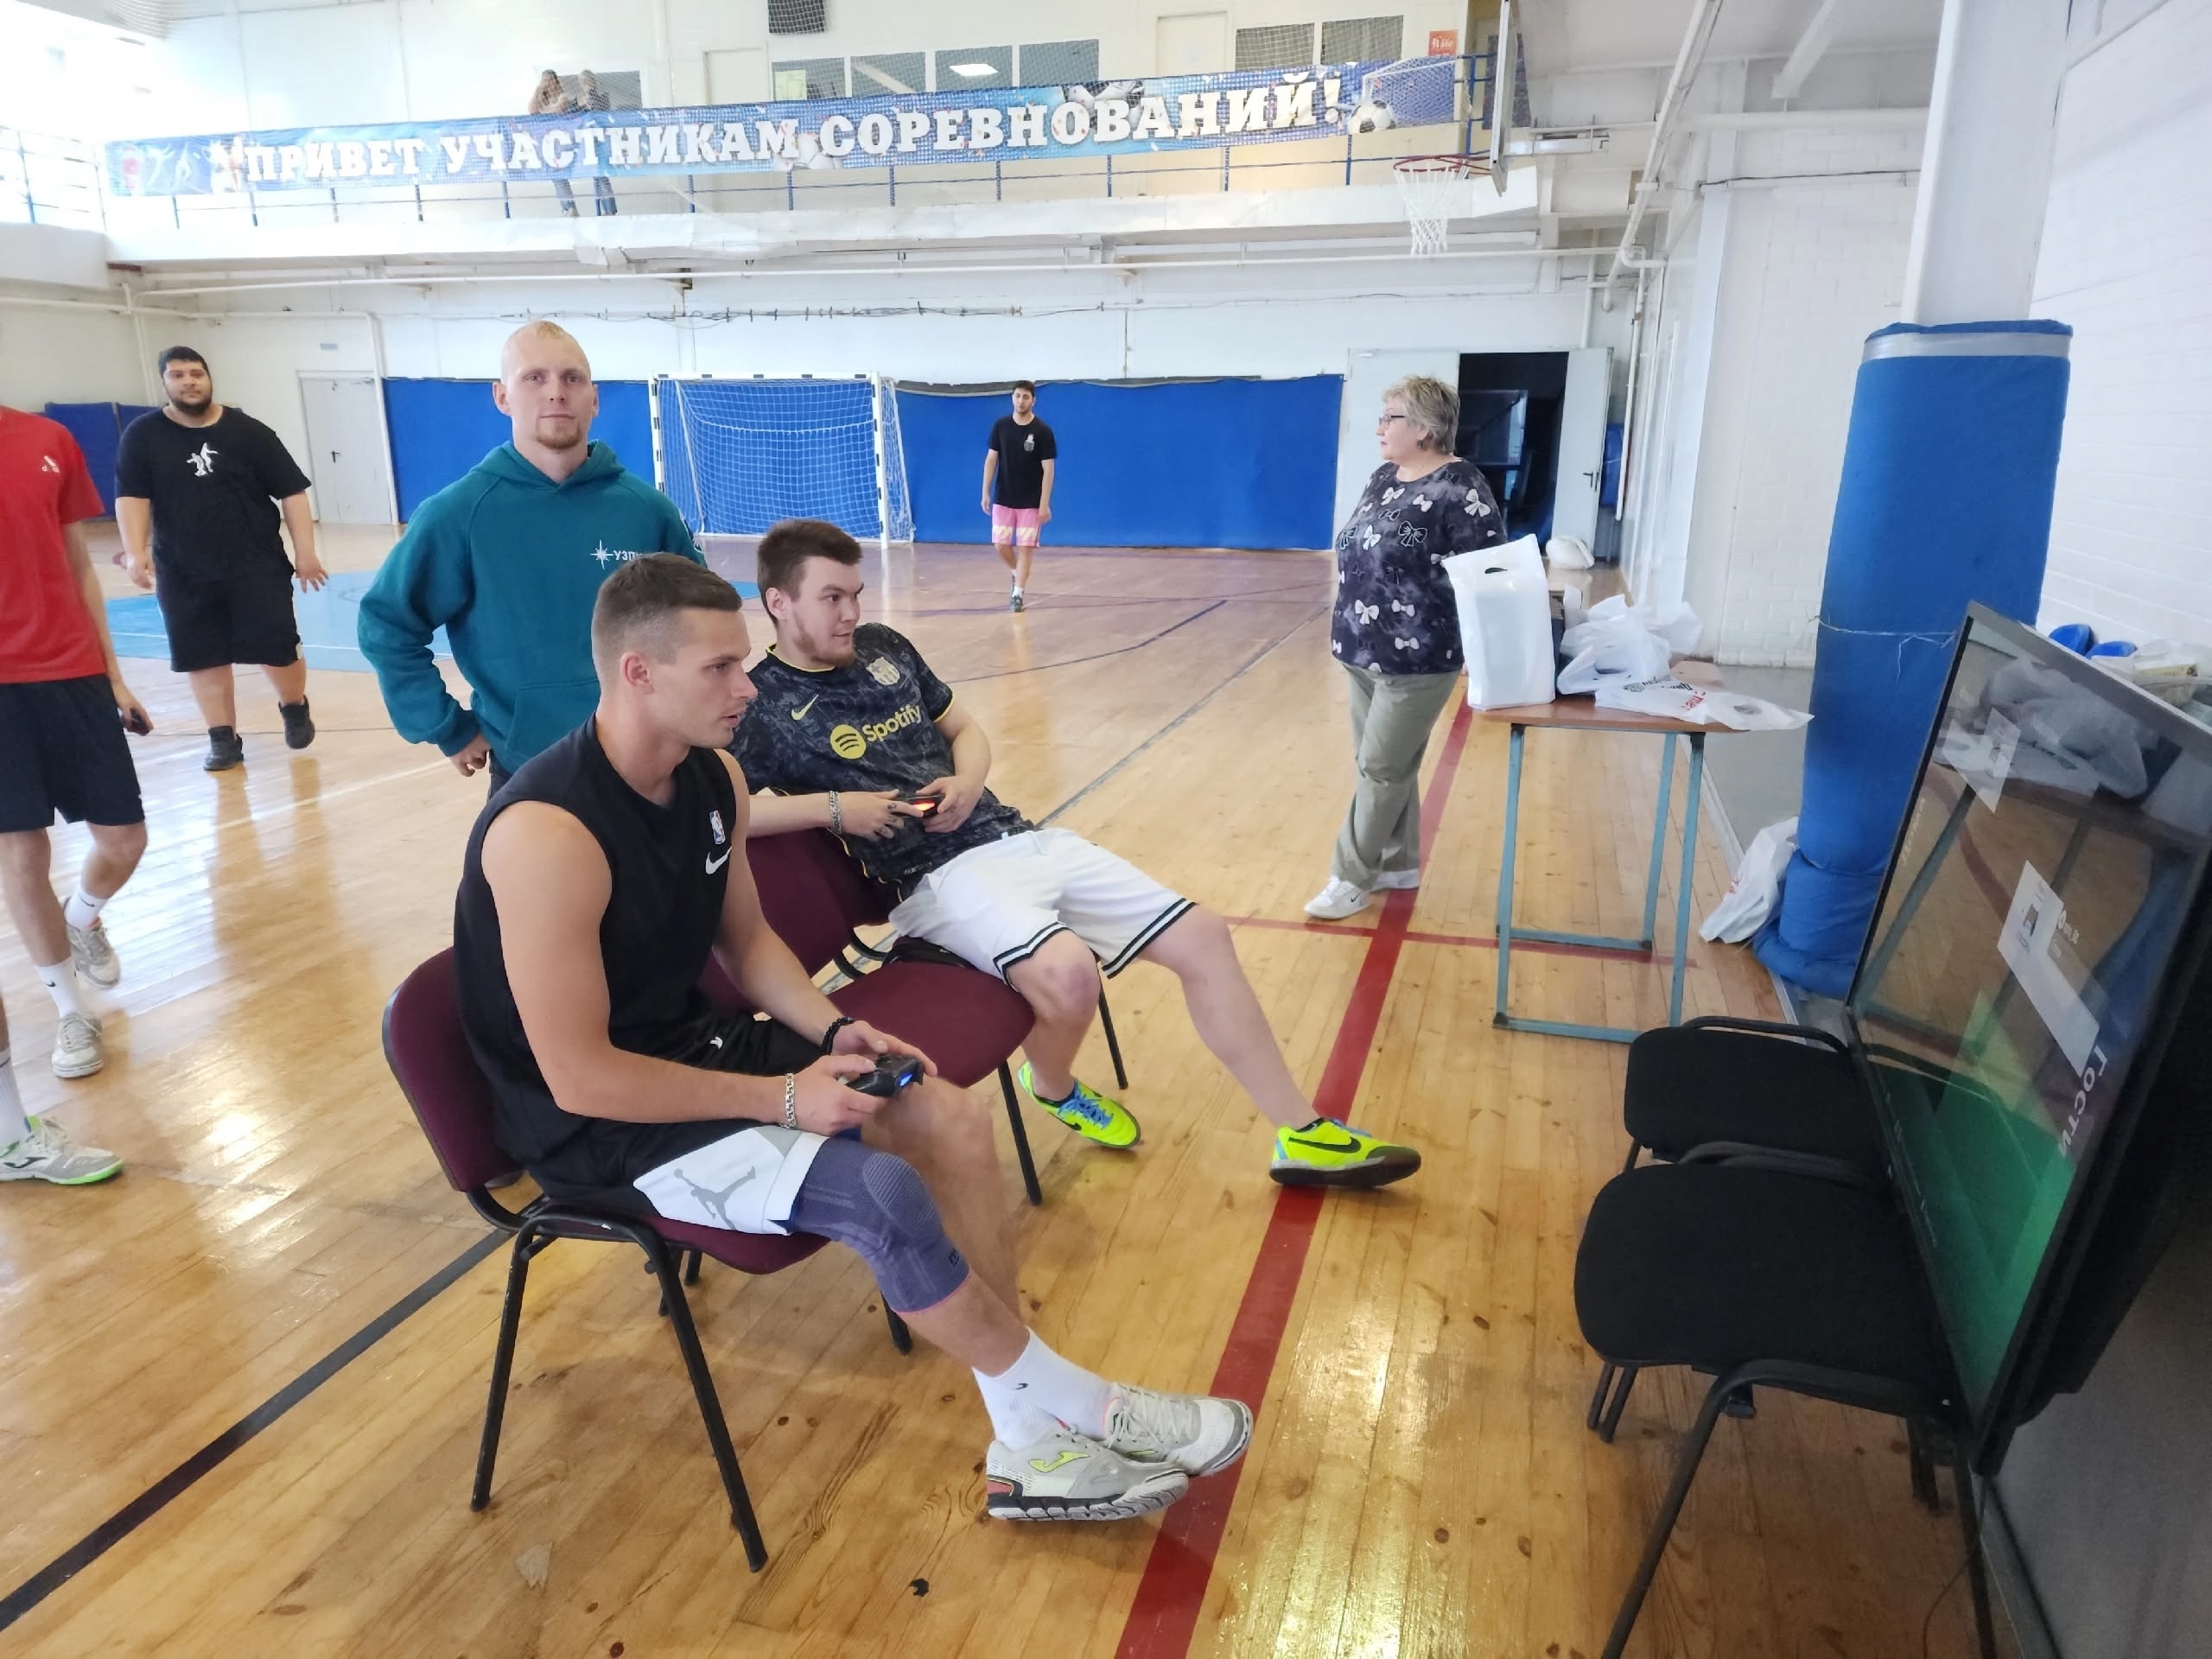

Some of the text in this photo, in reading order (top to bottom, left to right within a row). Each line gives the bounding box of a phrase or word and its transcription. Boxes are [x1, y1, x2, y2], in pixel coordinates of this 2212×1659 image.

[244, 71, 1341, 181] ПРИВЕТ УЧАСТНИКАМ СОРЕВНОВАНИЙ!
[613, 550, 644, 562] УЗП
[861, 704, 922, 742] Spotify
